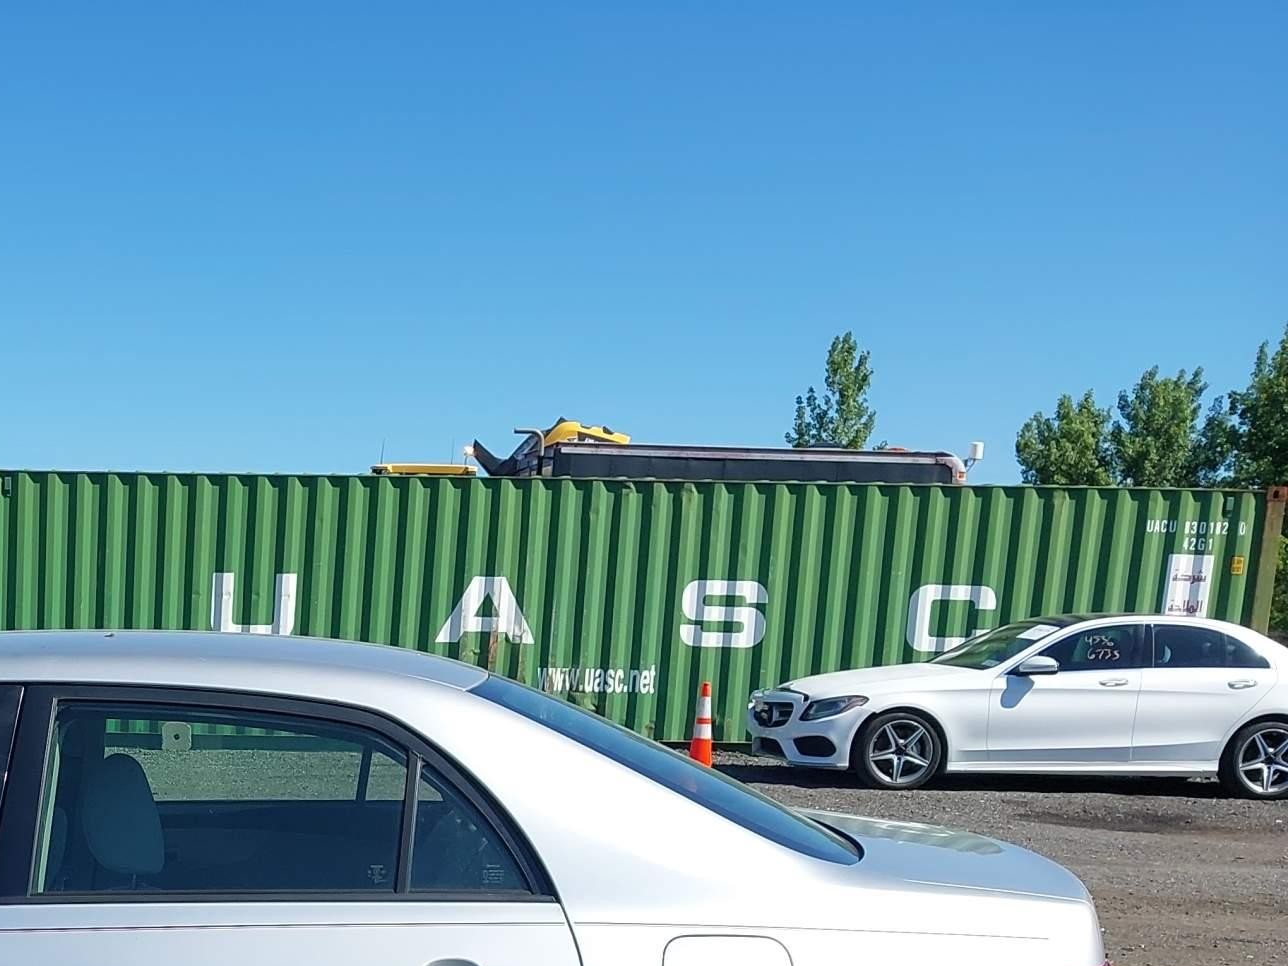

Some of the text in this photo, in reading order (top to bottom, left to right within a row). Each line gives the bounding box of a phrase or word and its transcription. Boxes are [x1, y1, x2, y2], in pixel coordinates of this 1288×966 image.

[1146, 519, 1177, 533] UACU
[1184, 520, 1229, 536] 830182
[1182, 537, 1214, 551] 42G1
[537, 664, 656, 695] www.uasc.net
